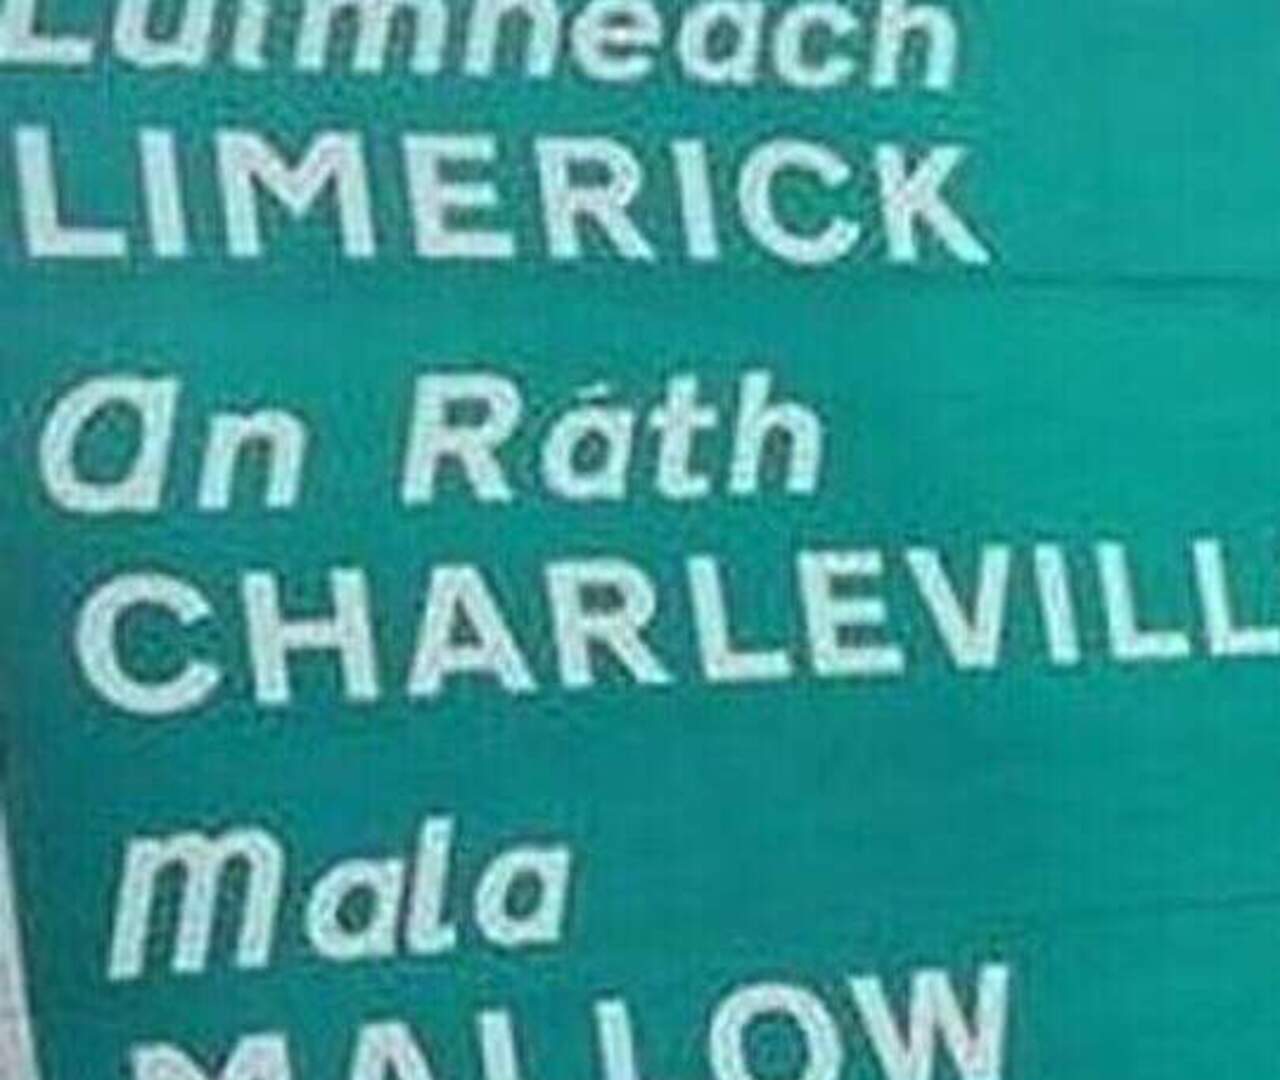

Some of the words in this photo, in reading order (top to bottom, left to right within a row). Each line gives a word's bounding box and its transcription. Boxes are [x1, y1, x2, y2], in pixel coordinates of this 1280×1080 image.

[15, 127, 988, 264] LIMERICK
[402, 372, 820, 503] Ráth
[109, 818, 570, 979] Mala
